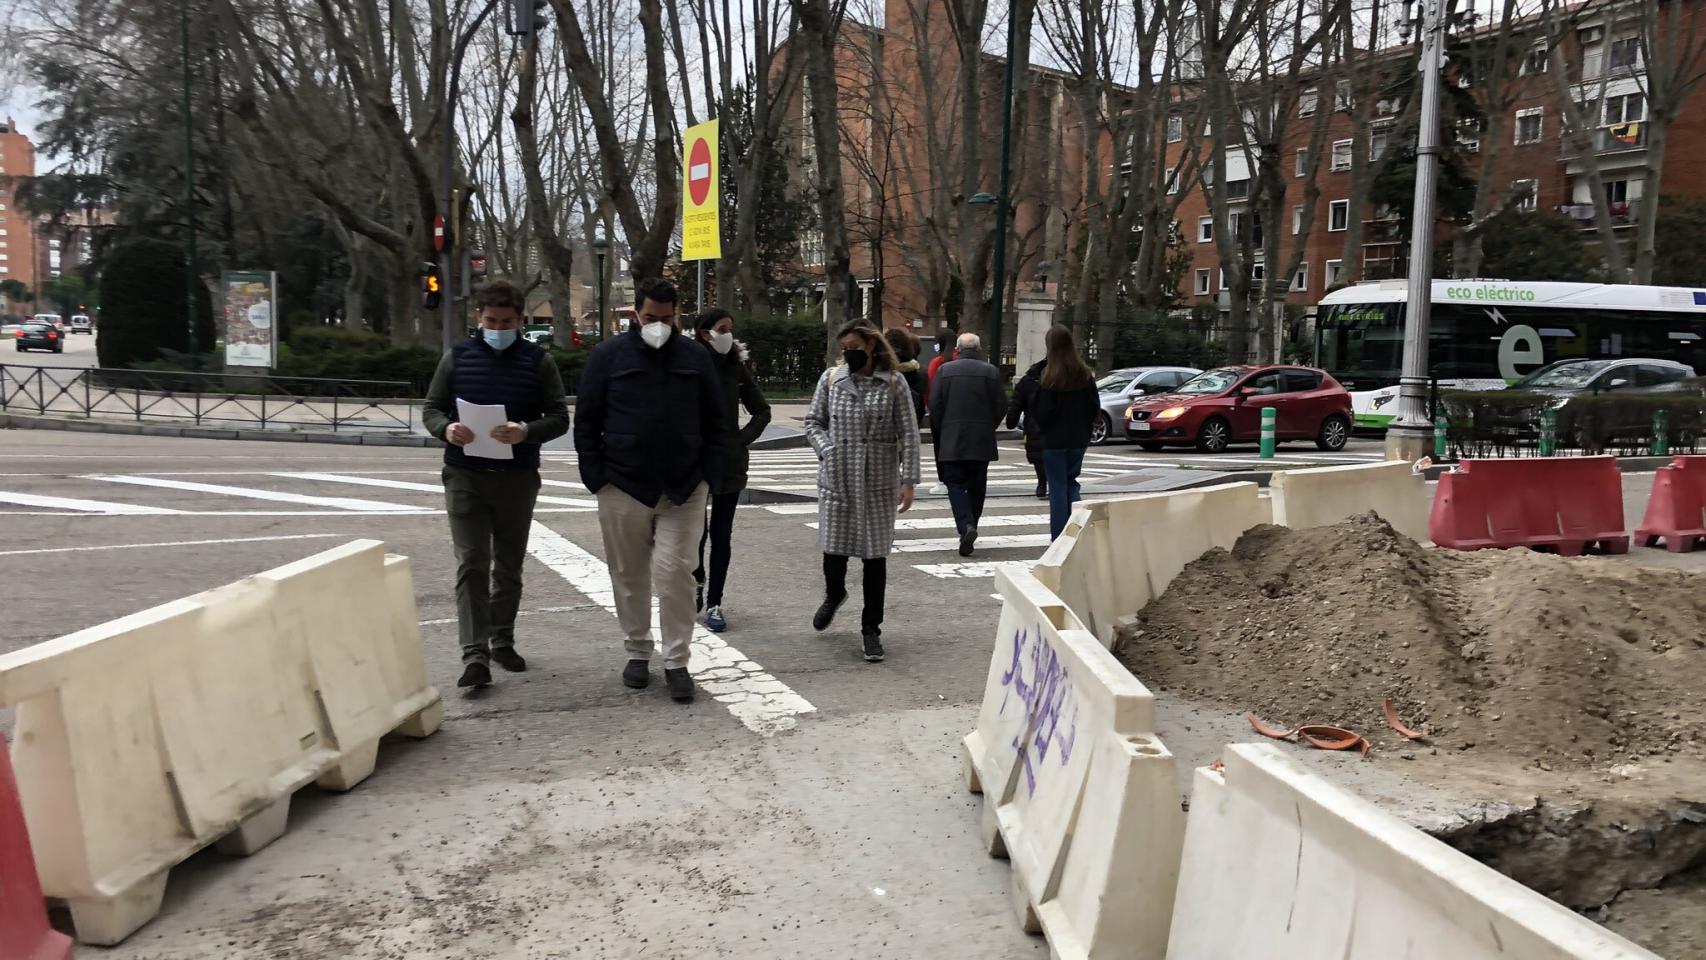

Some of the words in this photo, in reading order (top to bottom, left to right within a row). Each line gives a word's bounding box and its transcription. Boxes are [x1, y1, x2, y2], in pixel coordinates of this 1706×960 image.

[1447, 287, 1471, 298] eco
[1476, 285, 1535, 301] eléctrico
[1498, 324, 1544, 387] e
